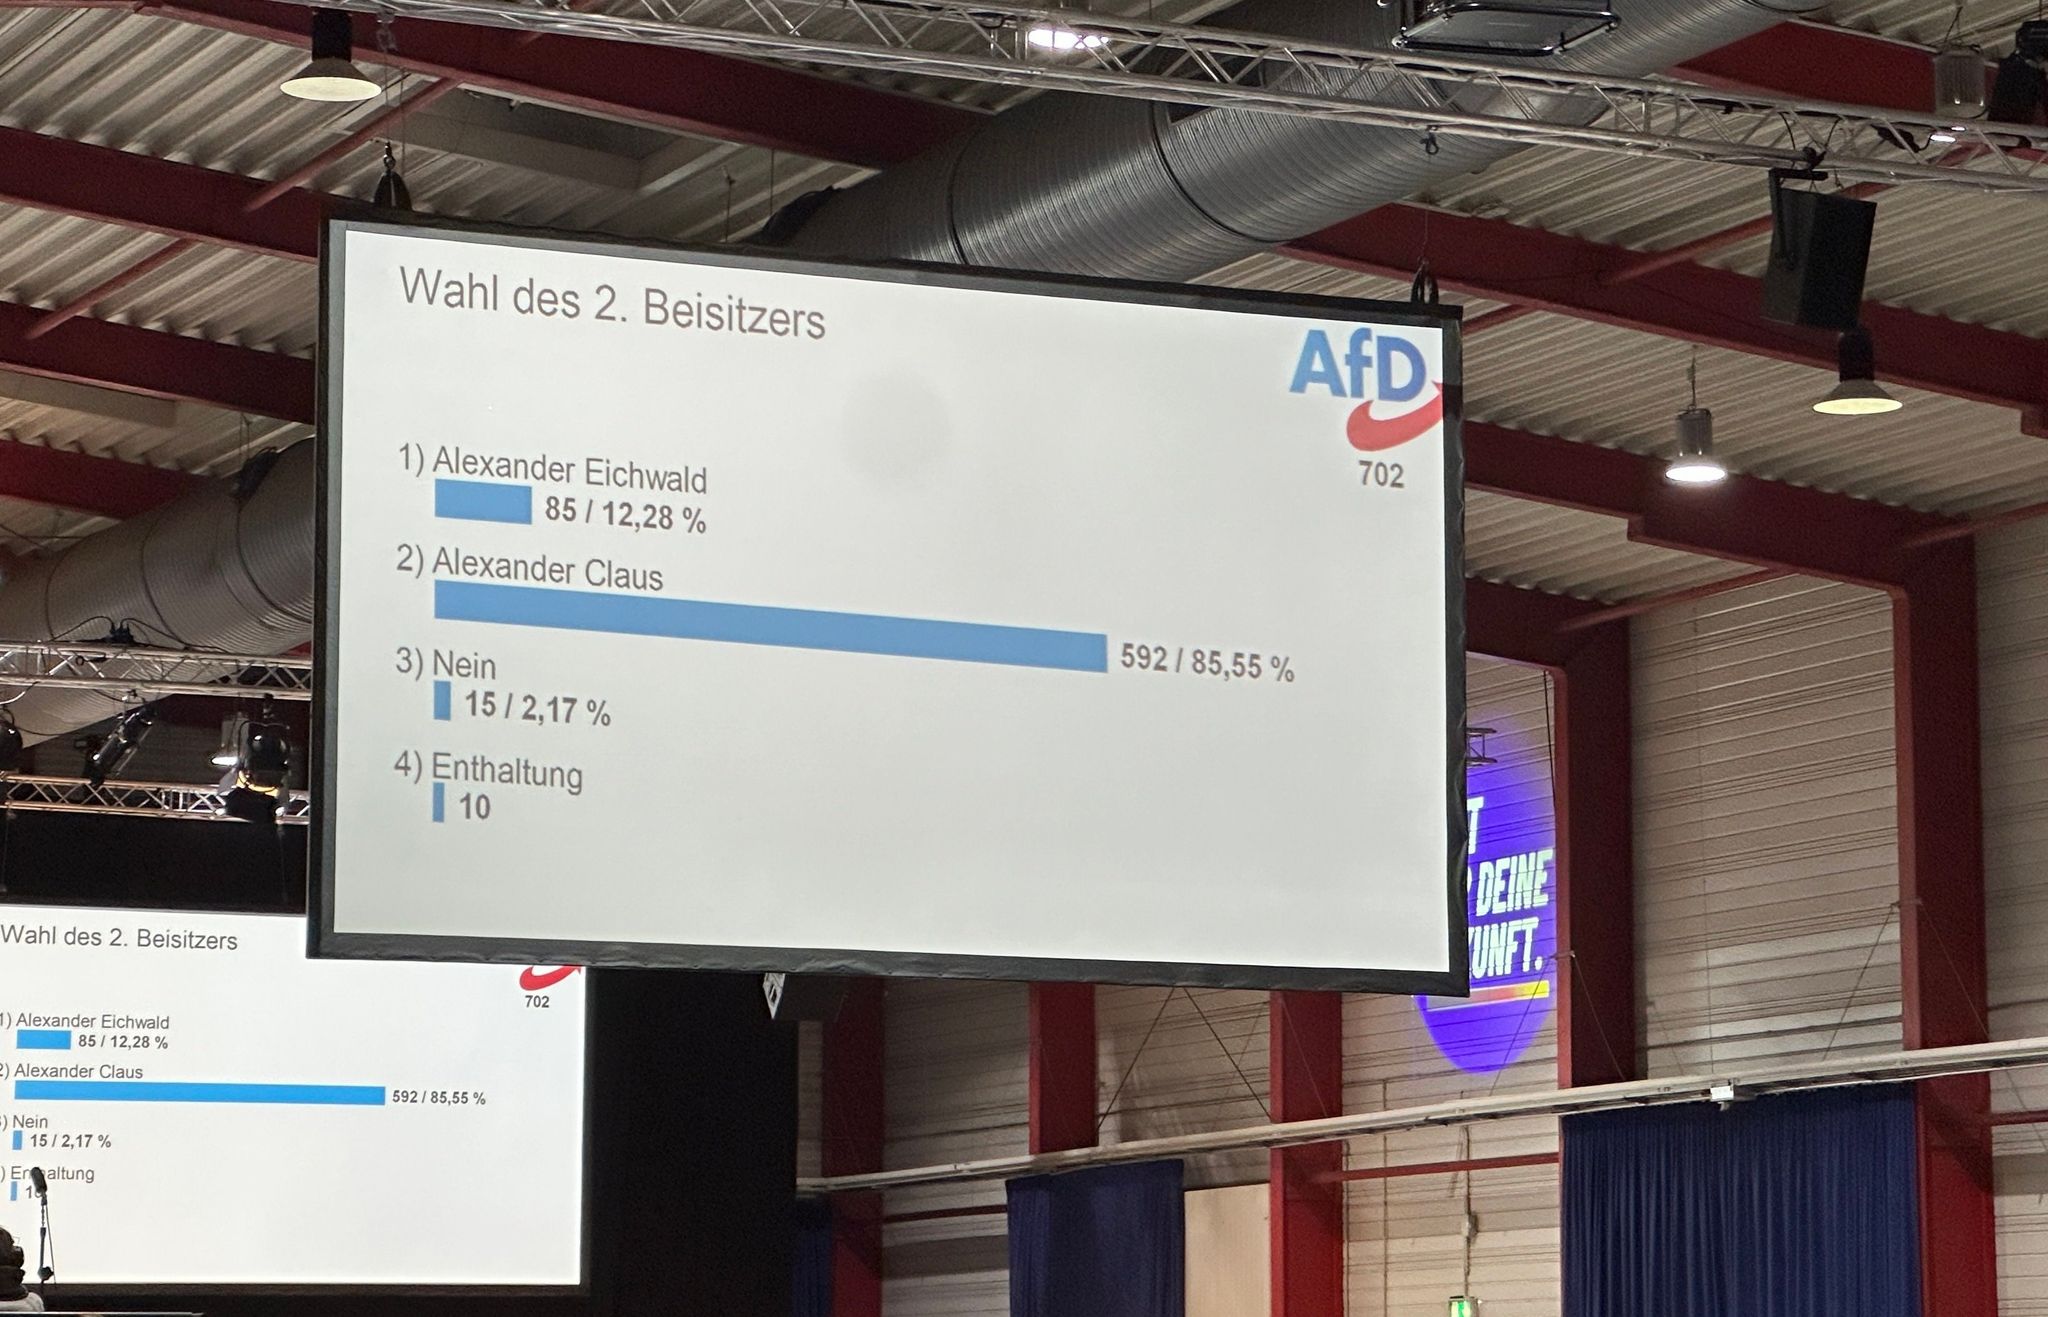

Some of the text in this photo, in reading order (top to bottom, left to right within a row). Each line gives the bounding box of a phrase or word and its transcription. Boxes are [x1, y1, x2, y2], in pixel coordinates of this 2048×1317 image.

[399, 265, 827, 340] Wahl des 2. Beisitzers
[1289, 327, 1427, 402] AfD
[399, 442, 707, 495] 1) Alexander Eichwald
[1358, 459, 1405, 489] 702
[545, 495, 707, 534] 85 / 12,28 %
[396, 543, 664, 592] 2) Alexander Claus
[396, 646, 497, 682] 3) Nein
[1121, 642, 1295, 683] 592 / 85,55 %
[465, 689, 612, 727] 15 / 2,17 %
[393, 749, 583, 796] 4) Enthaltung
[459, 792, 491, 821] 10
[1476, 848, 1553, 917] DEINE
[0, 924, 238, 951] Wahl des 2. Beisitzers
[1469, 916, 1543, 979] UNFT.
[525, 995, 550, 1008] 702
[16, 1012, 97, 1028] Alexander
[101, 1014, 170, 1030] Eichwald
[78, 1034, 96, 1048] 85
[110, 1035, 150, 1050] 12,28
[154, 1036, 169, 1049] %
[14, 1063, 94, 1078] Alexander
[99, 1064, 144, 1079] Claus
[392, 1089, 418, 1103] 592
[430, 1091, 469, 1106] 85,55
[473, 1092, 486, 1105] %
[13, 1114, 48, 1129] Nein
[30, 1134, 48, 1147] 15
[61, 1134, 93, 1149] 2,17
[98, 1134, 112, 1148] %
[11, 1165, 95, 1184] Enaltung
